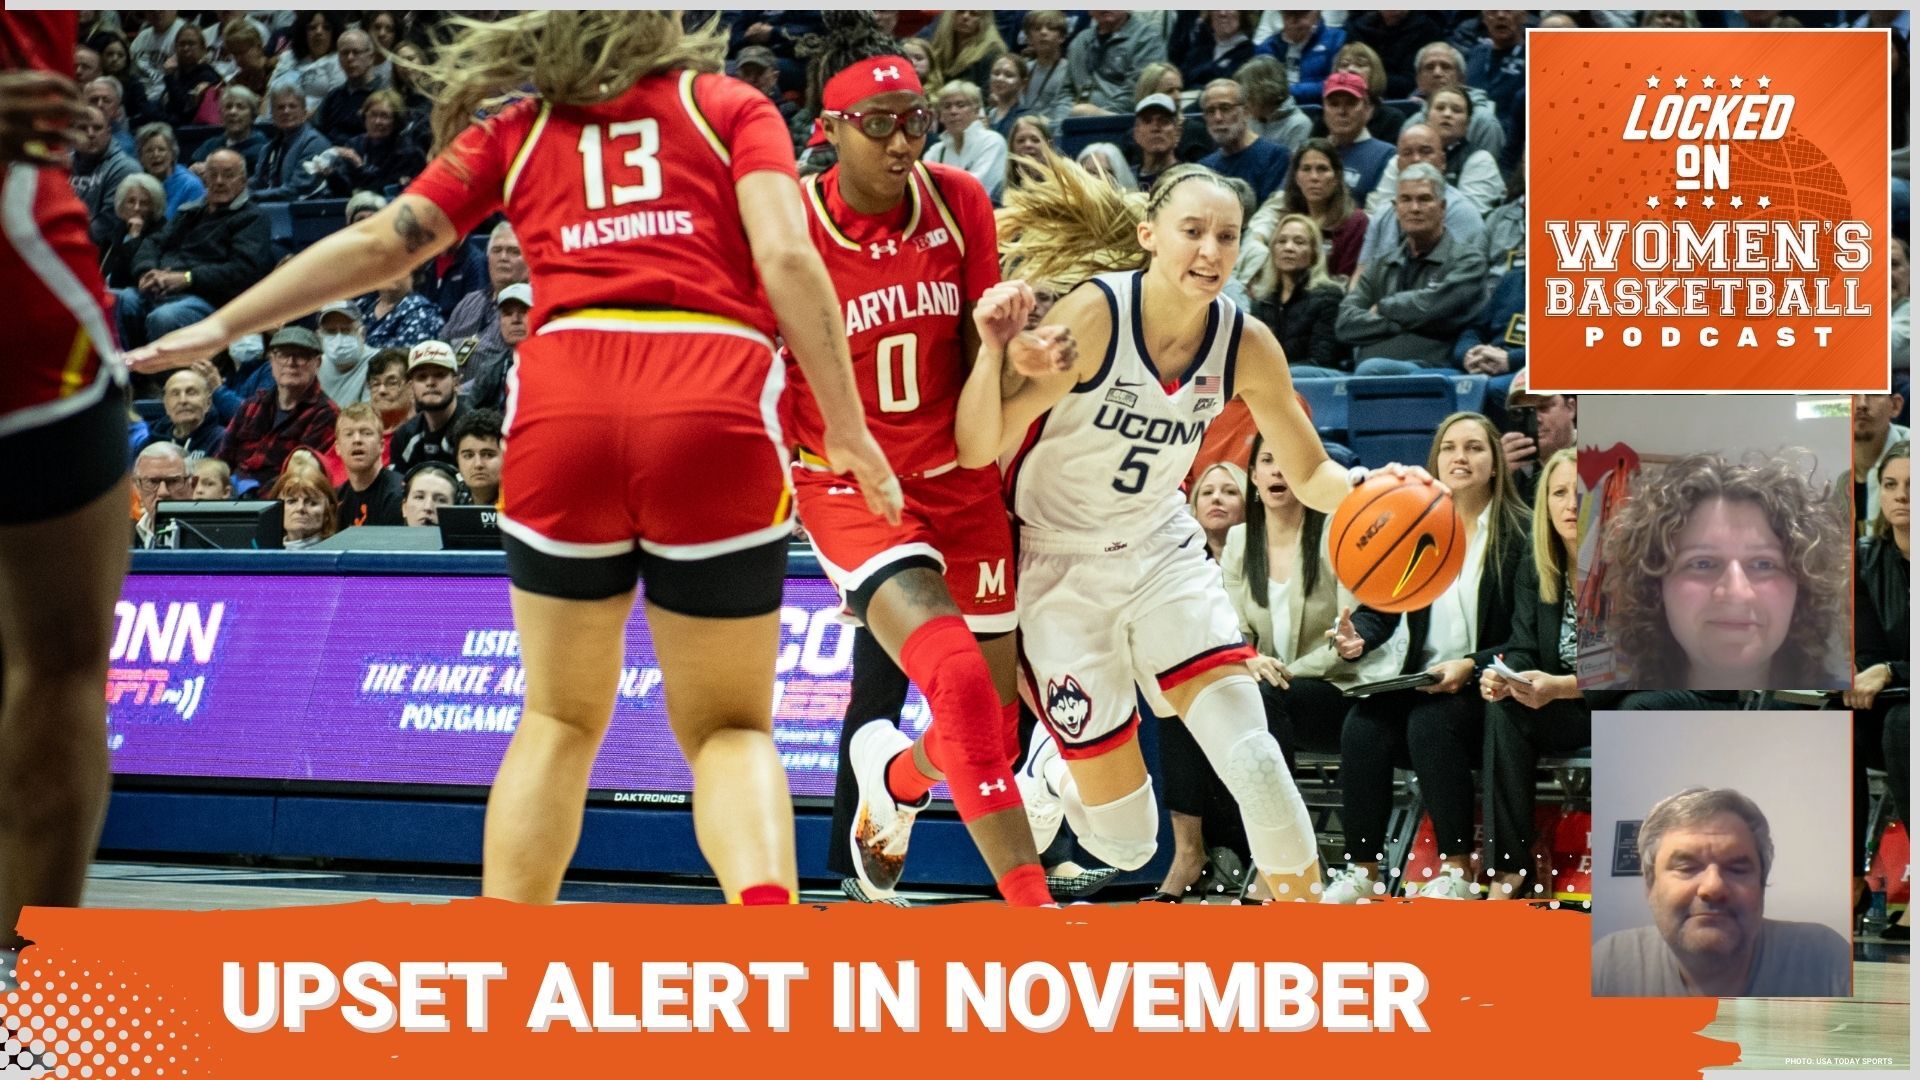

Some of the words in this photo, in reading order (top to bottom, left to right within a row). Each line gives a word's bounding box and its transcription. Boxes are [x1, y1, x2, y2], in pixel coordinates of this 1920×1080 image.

[577, 117, 663, 210] 13
[560, 209, 694, 254] MASONIUS
[876, 332, 920, 413] 0
[1111, 445, 1161, 494] 5
[975, 558, 1007, 598] M
[362, 664, 412, 693] THE
[411, 665, 495, 696] HARTE
[399, 702, 521, 732] POSTGAME
[614, 792, 686, 804] DAKTRONICS
